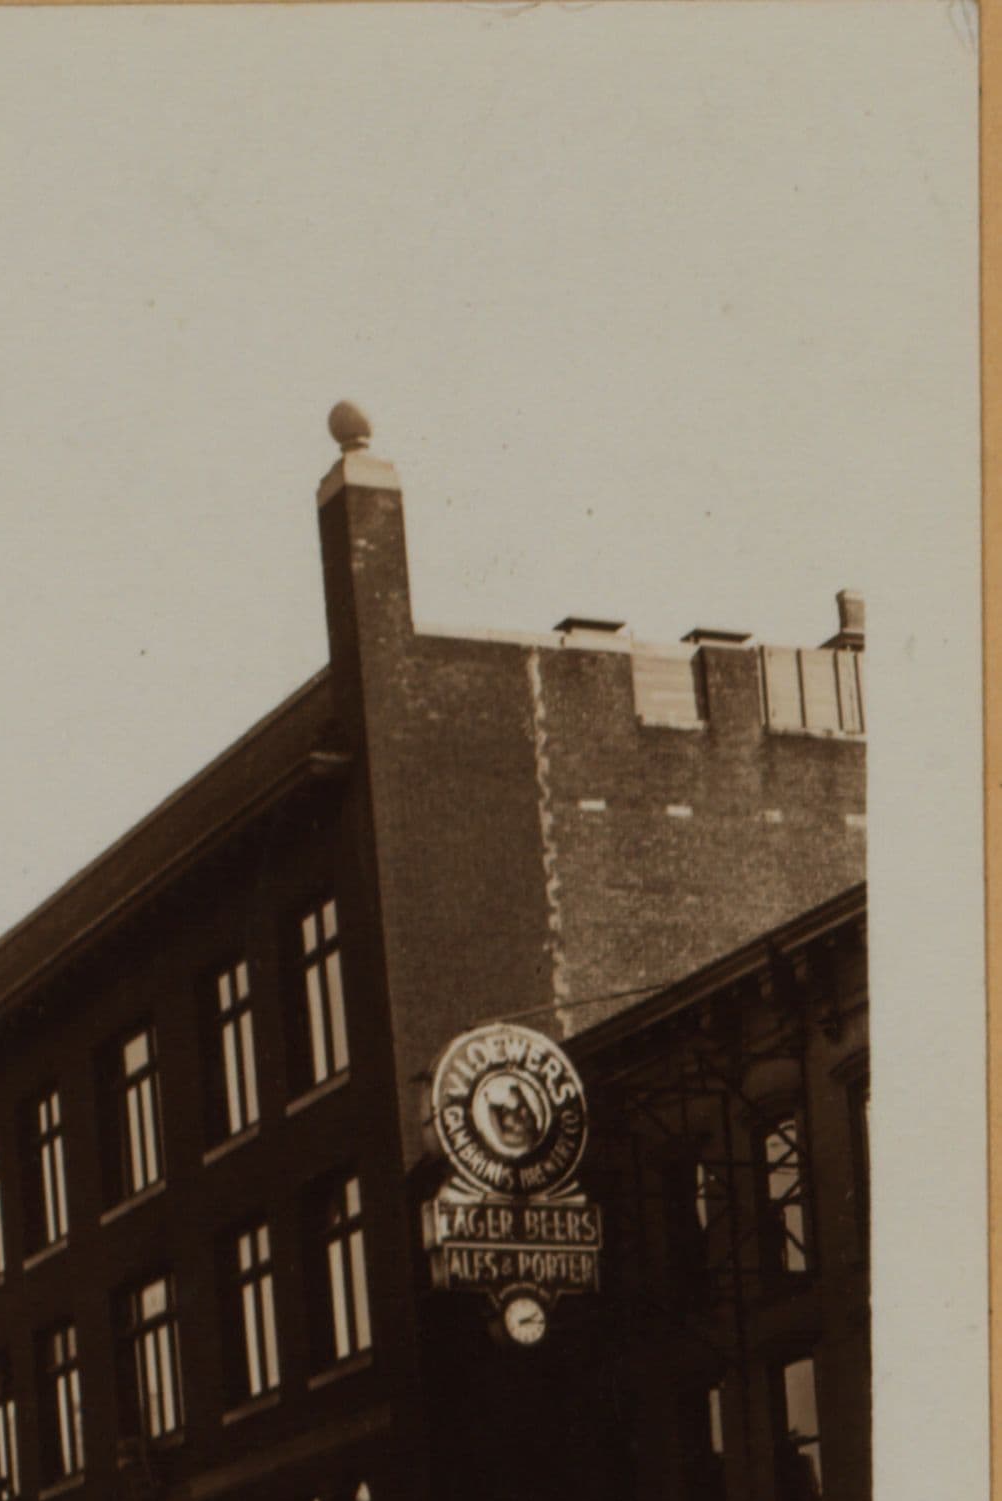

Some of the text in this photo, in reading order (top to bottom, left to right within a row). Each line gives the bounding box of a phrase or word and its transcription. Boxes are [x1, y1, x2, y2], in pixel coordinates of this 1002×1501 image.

[438, 1205, 596, 1242] LAGER BEERS
[450, 1250, 593, 1284] ALES & PORTER
